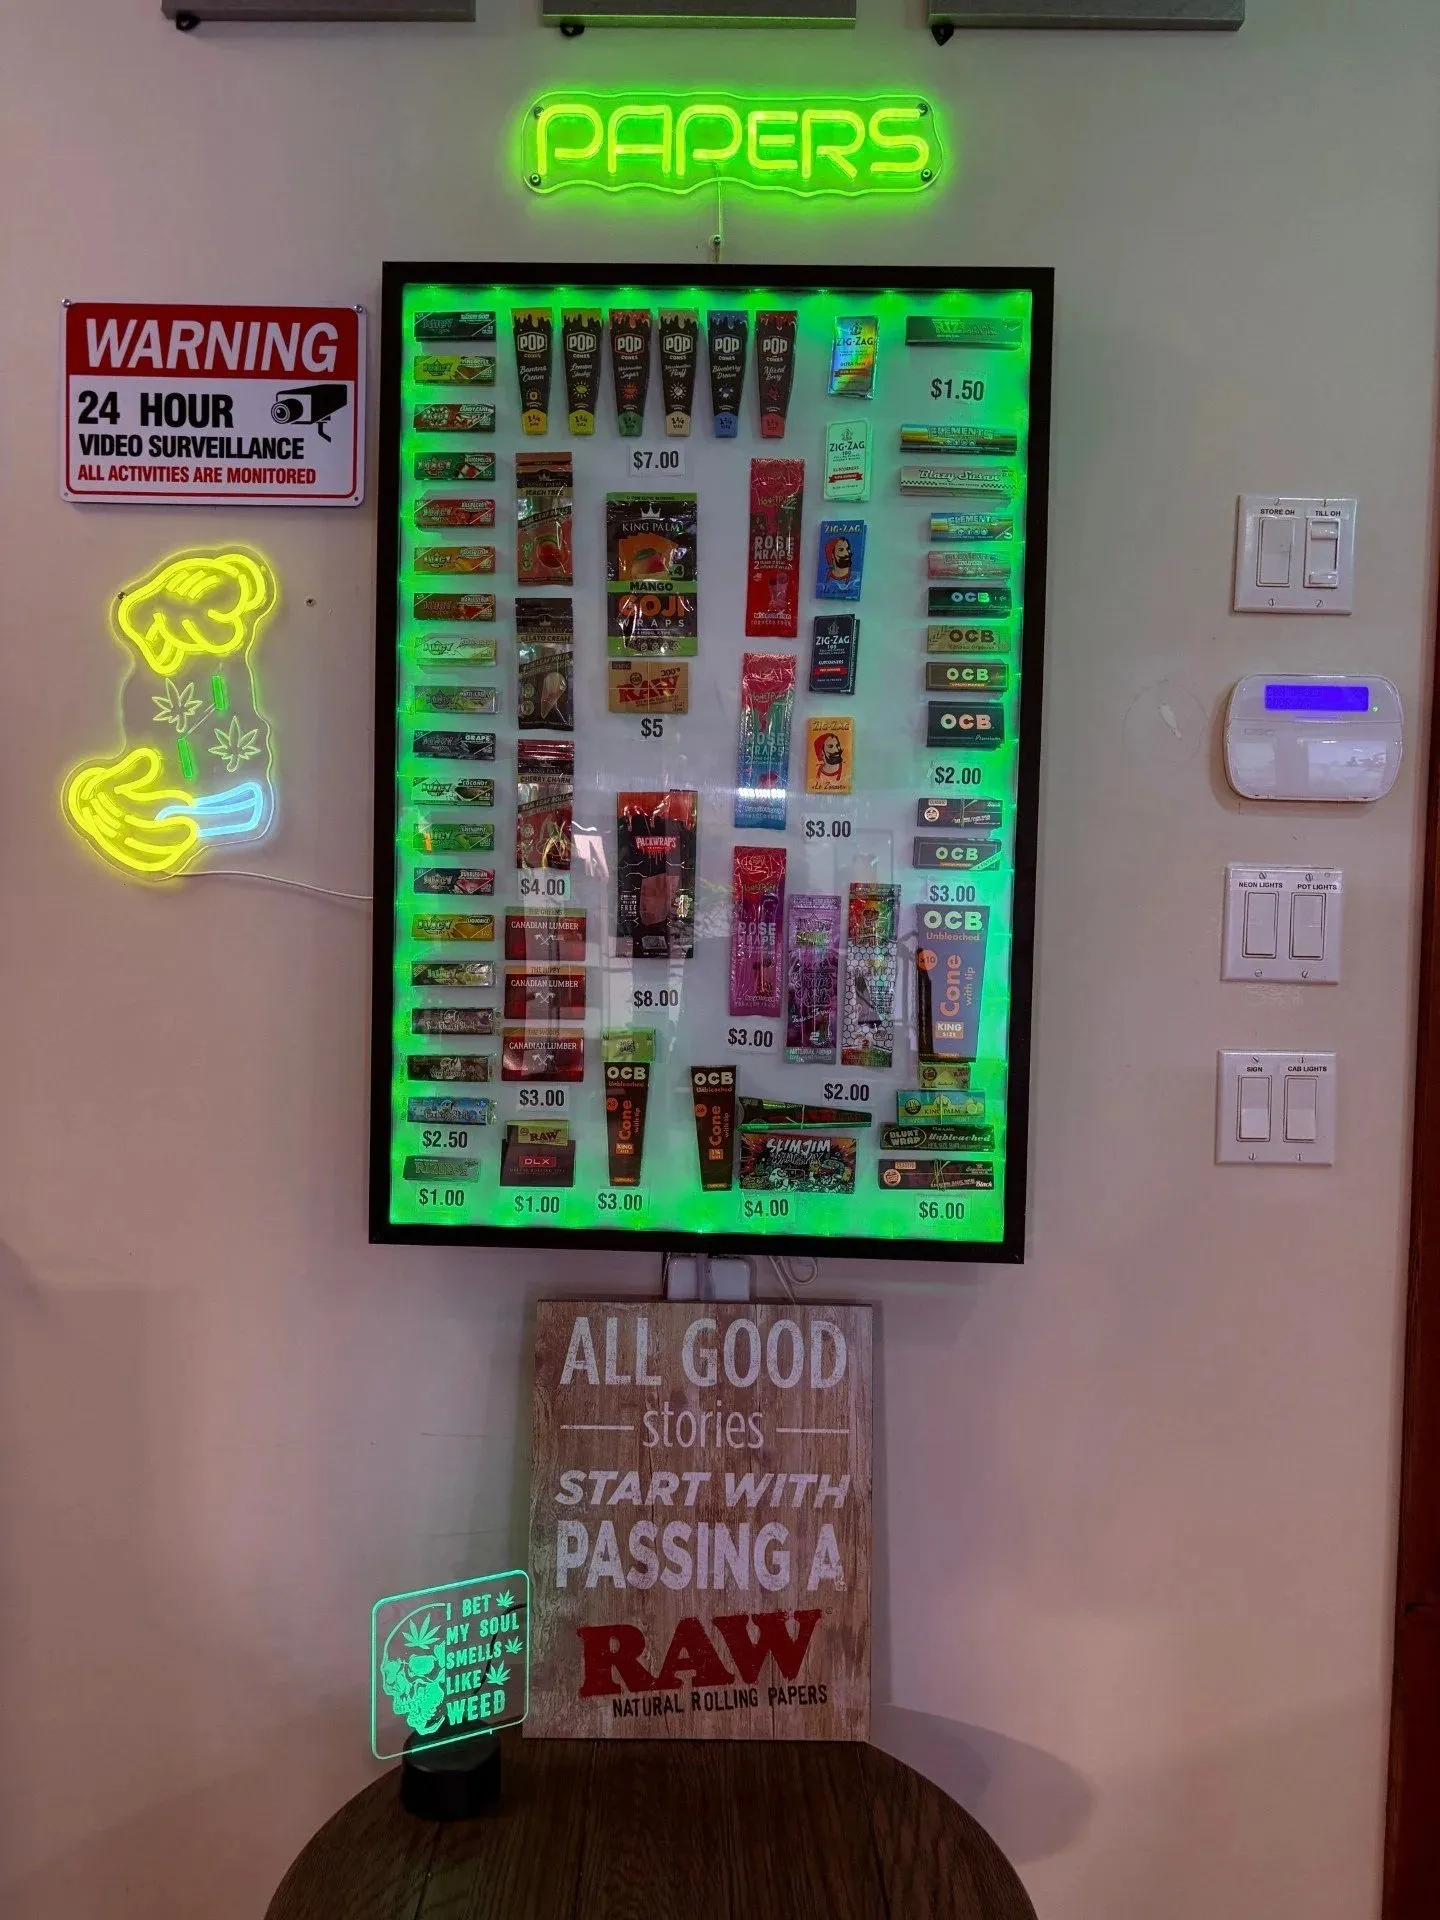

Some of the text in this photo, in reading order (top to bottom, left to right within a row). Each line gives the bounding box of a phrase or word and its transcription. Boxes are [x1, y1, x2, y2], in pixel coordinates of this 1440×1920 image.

[536, 104, 930, 179] PAPERS
[86, 318, 338, 372] WARNING
[520, 334, 545, 349] POP
[569, 334, 594, 349] POP
[618, 336, 642, 352] POP
[666, 336, 691, 352] POP
[715, 337, 740, 353] POP
[763, 337, 788, 354] POP
[836, 337, 873, 346] ZIG-ZAG
[931, 378, 984, 401] $1.50
[78, 391, 234, 428] 24 HOUR
[929, 427, 994, 439] ELEMENTS
[79, 434, 304, 459] VIDEO SURVEILLANCE
[829, 441, 865, 452] ZIG-ZAG
[634, 451, 679, 470] $7.00
[78, 465, 316, 484] ALL ACTIVITIES ARE MONITORED
[919, 470, 1000, 481] Blazy Susan
[623, 523, 678, 531] KING PALM
[825, 525, 861, 533] ZIG-ZAG
[947, 516, 999, 525] ELEMENTS
[754, 535, 794, 549] ROSE
[754, 549, 794, 561] WRAPS
[754, 561, 759, 569] 2
[630, 582, 673, 591] MANGO
[951, 592, 990, 602] OCB
[619, 595, 685, 617] GOJI
[816, 636, 850, 645] ZIG-ZAG
[949, 630, 994, 642] OCB
[947, 668, 989, 680] OCB
[617, 675, 679, 703] RAW
[641, 718, 663, 738] $5
[813, 721, 849, 731] ZIG-ZAG
[941, 714, 991, 729] OCB
[935, 767, 981, 785] $2.00
[806, 820, 851, 839] $3.00
[636, 836, 676, 848] PACKWRAPS
[936, 847, 978, 860] OCB
[521, 878, 565, 896] $4.00
[930, 886, 975, 902] $3.00
[417, 919, 453, 930] JUICY
[511, 921, 578, 930] CANADIAN LUMBER
[924, 910, 982, 930] OCB
[738, 923, 776, 935] ROSE
[926, 932, 980, 941] Unbleached
[549, 980, 578, 988] LUMBER
[940, 955, 962, 1016] Cone
[965, 967, 976, 1005] with tip
[634, 990, 678, 1007] $8.00
[937, 1023, 962, 1031] KING
[509, 1042, 545, 1050] CANADIAN
[728, 1028, 773, 1047] $3.00
[607, 1067, 646, 1080] OCB
[694, 1072, 733, 1085] OCB
[520, 1089, 564, 1107] $3.00
[824, 1083, 869, 1101] $2.00
[619, 1100, 632, 1140] Cone
[709, 1106, 721, 1146] Cone
[423, 1130, 467, 1148] $2.50
[530, 1130, 561, 1142] RAW
[890, 1130, 918, 1139] BLUNT
[891, 1137, 921, 1146] WRAP
[419, 1188, 464, 1206] $1.00
[514, 1195, 559, 1213] $1.00
[598, 1193, 642, 1211] $3.00
[745, 1199, 789, 1217] $4.00
[919, 1201, 964, 1219] $6.00
[560, 1317, 847, 1389] ALL GOOD
[643, 1400, 764, 1449] stories
[554, 1470, 850, 1509] START WITH
[555, 1520, 847, 1591] PASSING A
[446, 1594, 491, 1620] I BET
[446, 1613, 519, 1645] MY SOUL
[446, 1641, 501, 1669] SMELLS
[576, 1608, 822, 1699] RAW
[446, 1670, 481, 1695] LIKE
[446, 1690, 505, 1725] WEED
[613, 1685, 827, 1718] NATURAL ROLLING PAPERS
